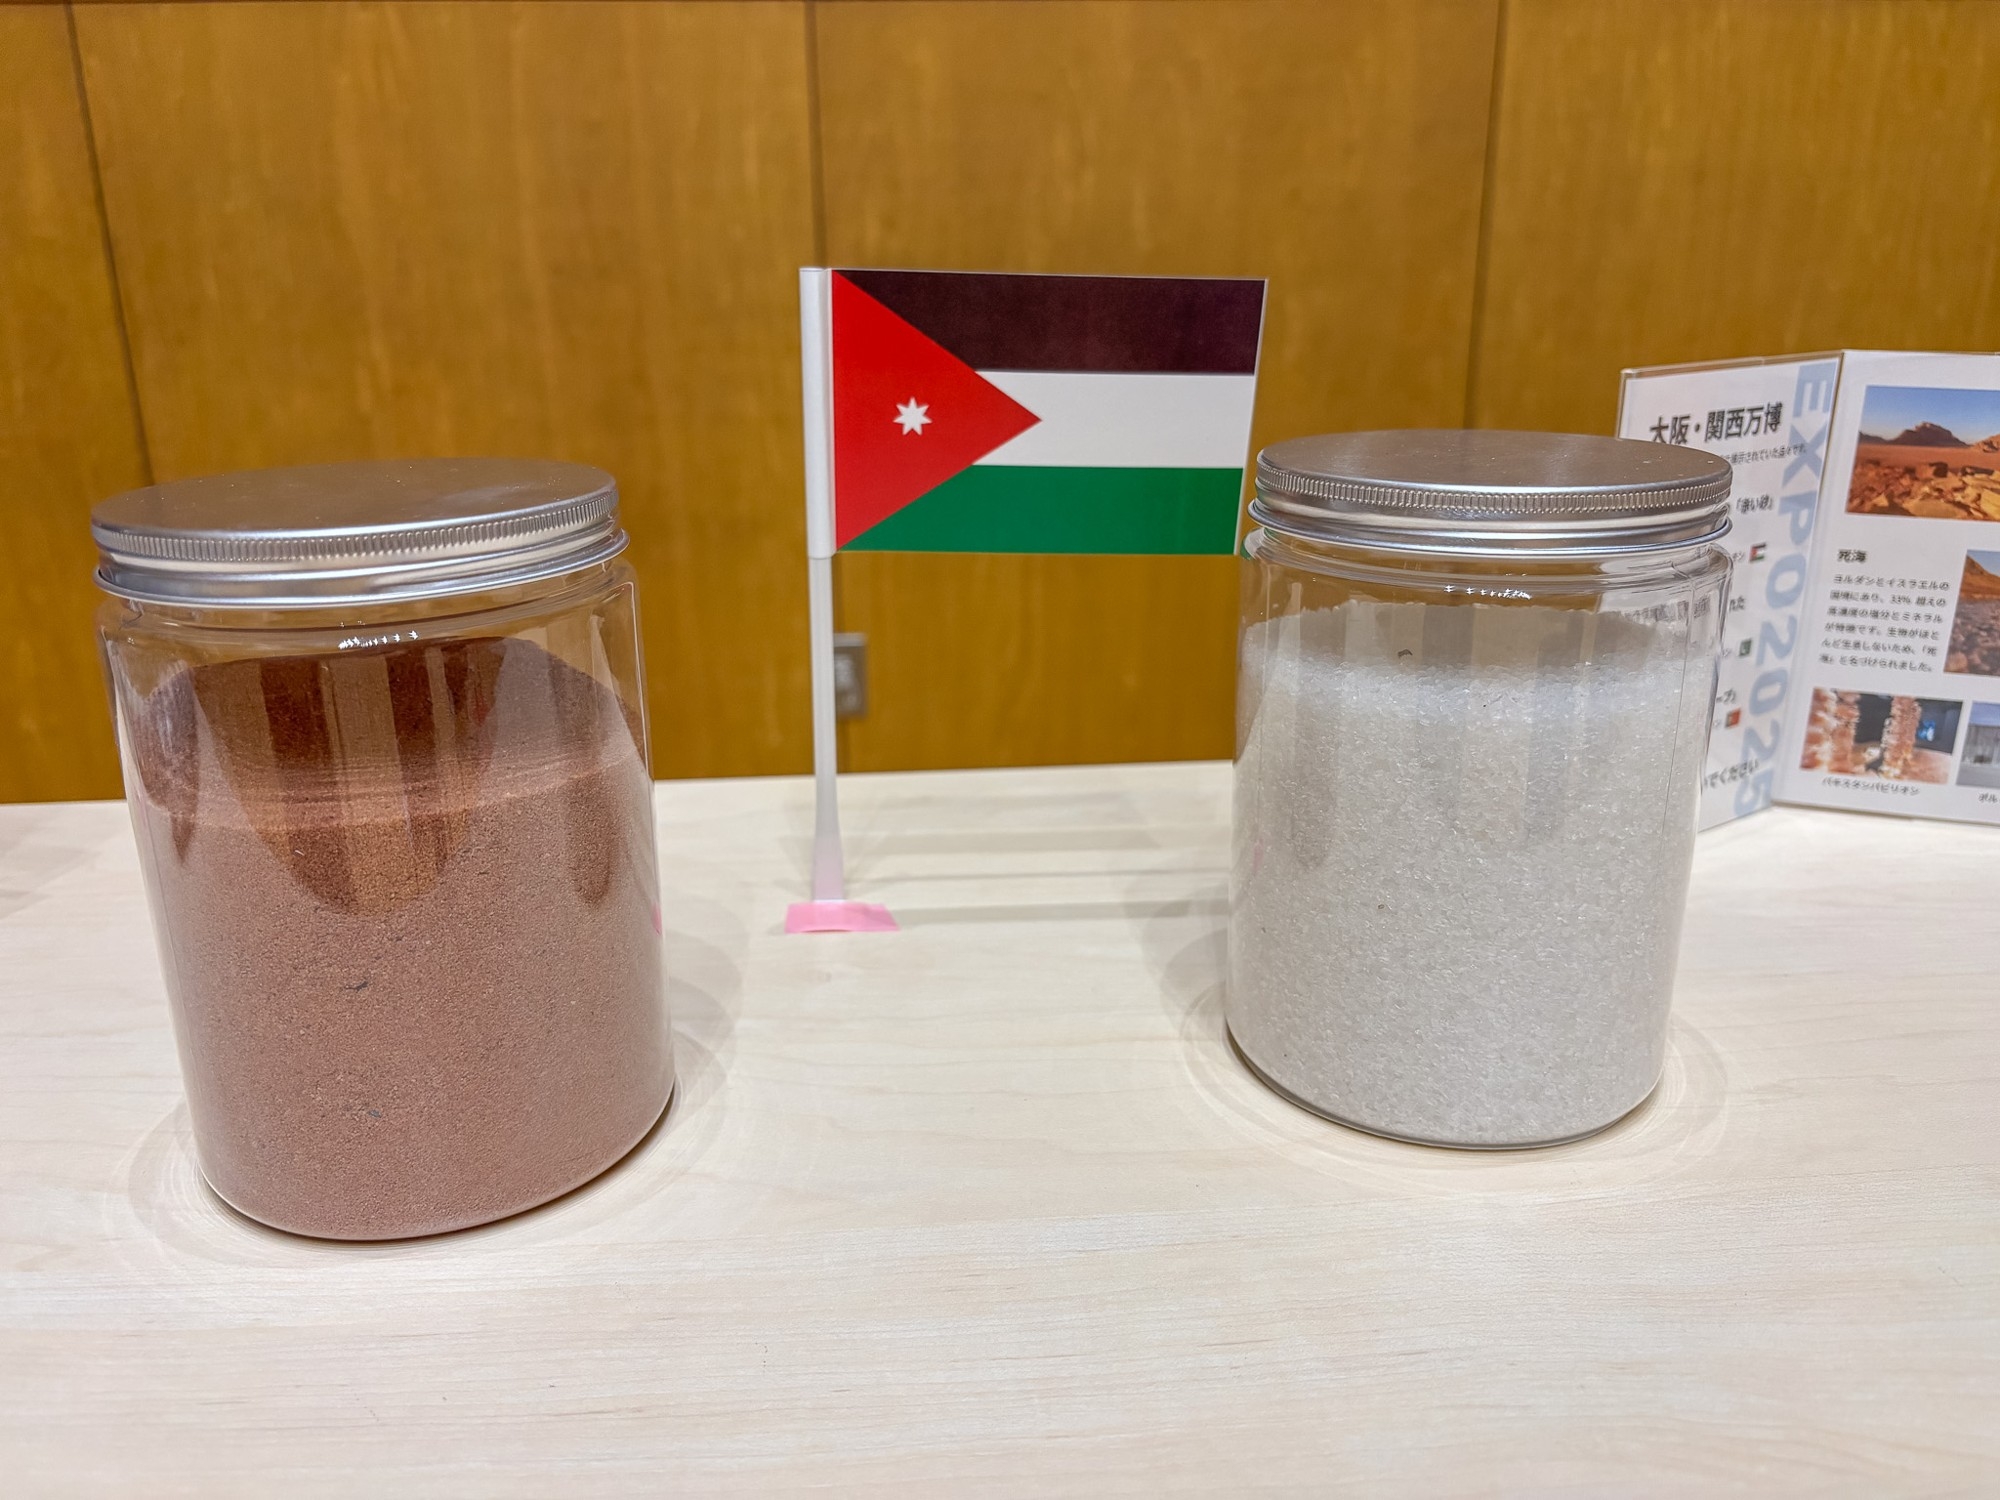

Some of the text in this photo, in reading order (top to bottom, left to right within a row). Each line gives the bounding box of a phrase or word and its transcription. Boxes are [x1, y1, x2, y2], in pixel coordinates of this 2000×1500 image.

[1650, 402, 1783, 445] 大阪・関西万博
[1837, 549, 1867, 564] 死海
[1733, 362, 1836, 817] EXPO2025
[1833, 574, 1950, 591] ヨルダンとイスラエルの
[1827, 606, 1943, 624] 高濃度の塩分とミネラル
[1824, 622, 1940, 640] が特徴です。生物がほと
[1821, 639, 1938, 656] んど生息しないため、「死
[1818, 653, 1933, 673] 海」と名づけられました。
[1822, 777, 1920, 796] パキスタンパビリオン
[1978, 792, 2000, 805] ポル
